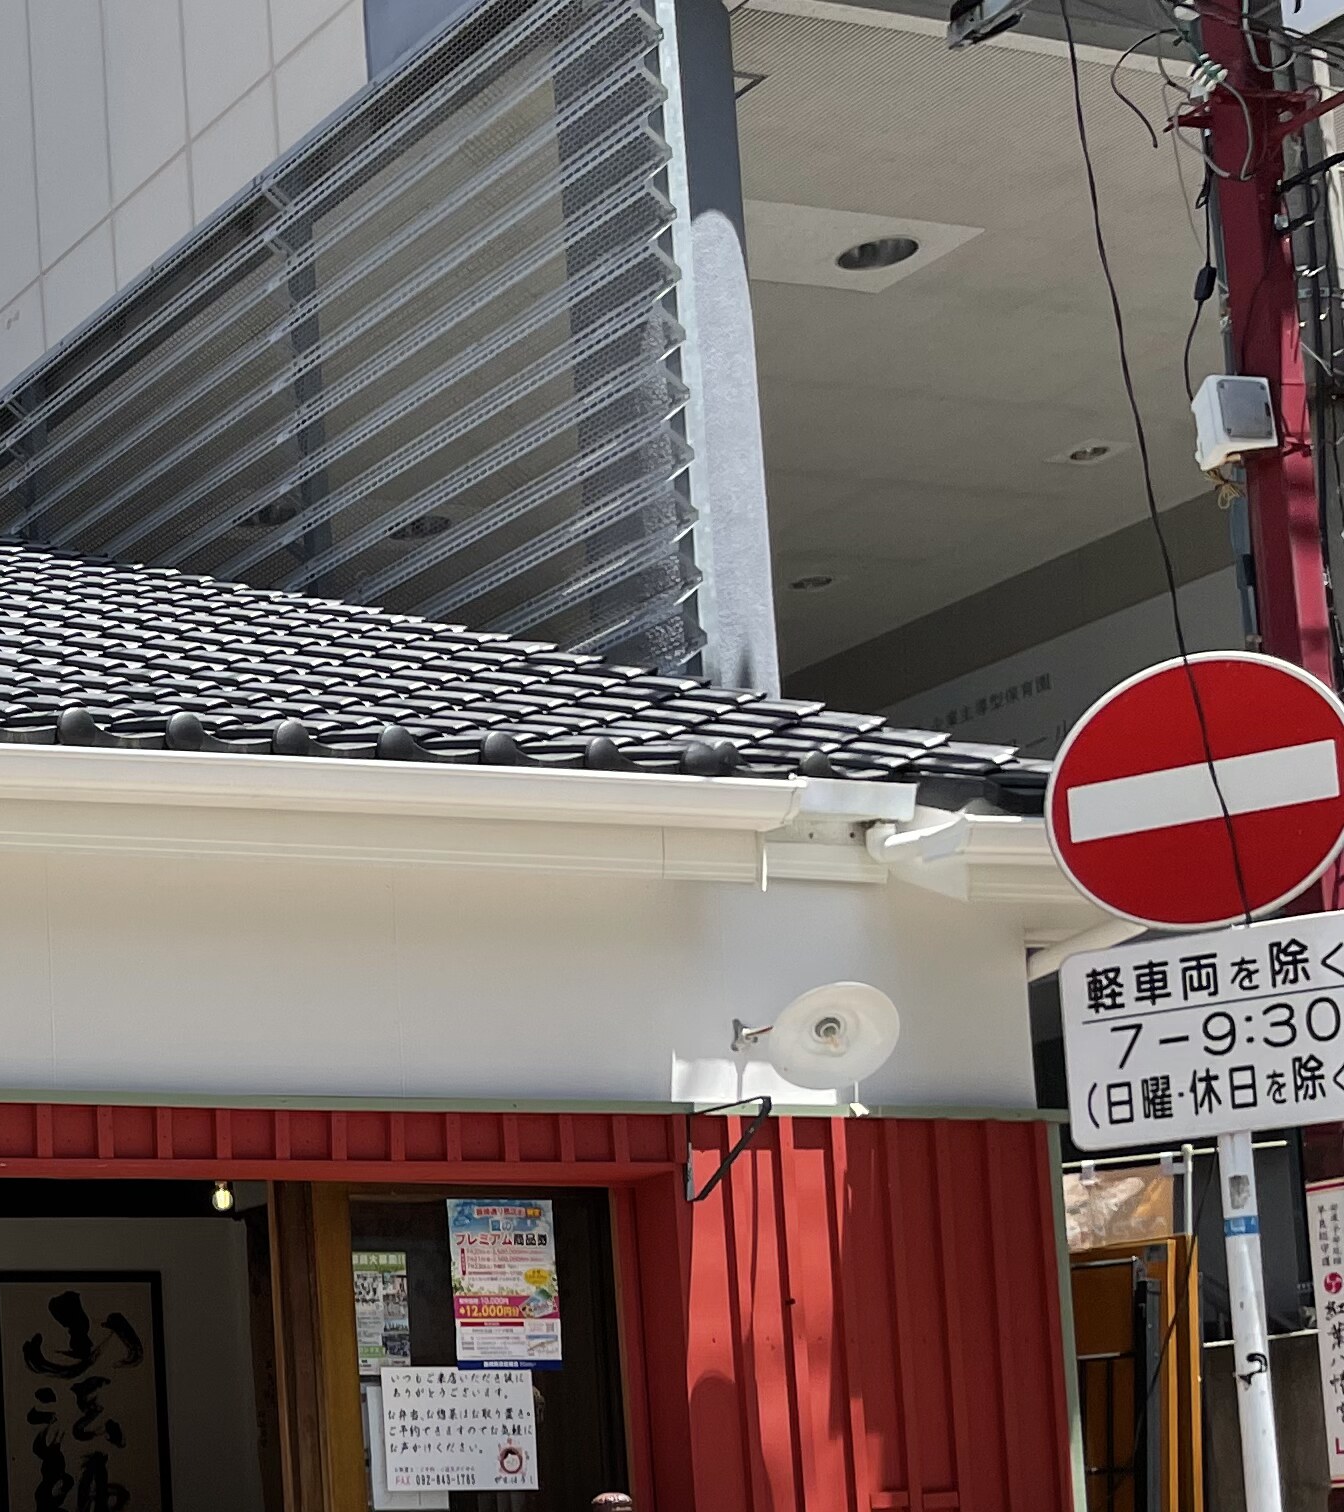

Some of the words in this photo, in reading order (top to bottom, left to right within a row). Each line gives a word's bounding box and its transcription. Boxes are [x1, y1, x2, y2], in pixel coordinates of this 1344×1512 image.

[1085, 938, 1344, 1014] 軽車両を除く
[1110, 997, 1341, 1070] 7-9:30
[395, 1475, 410, 1486] FAX
